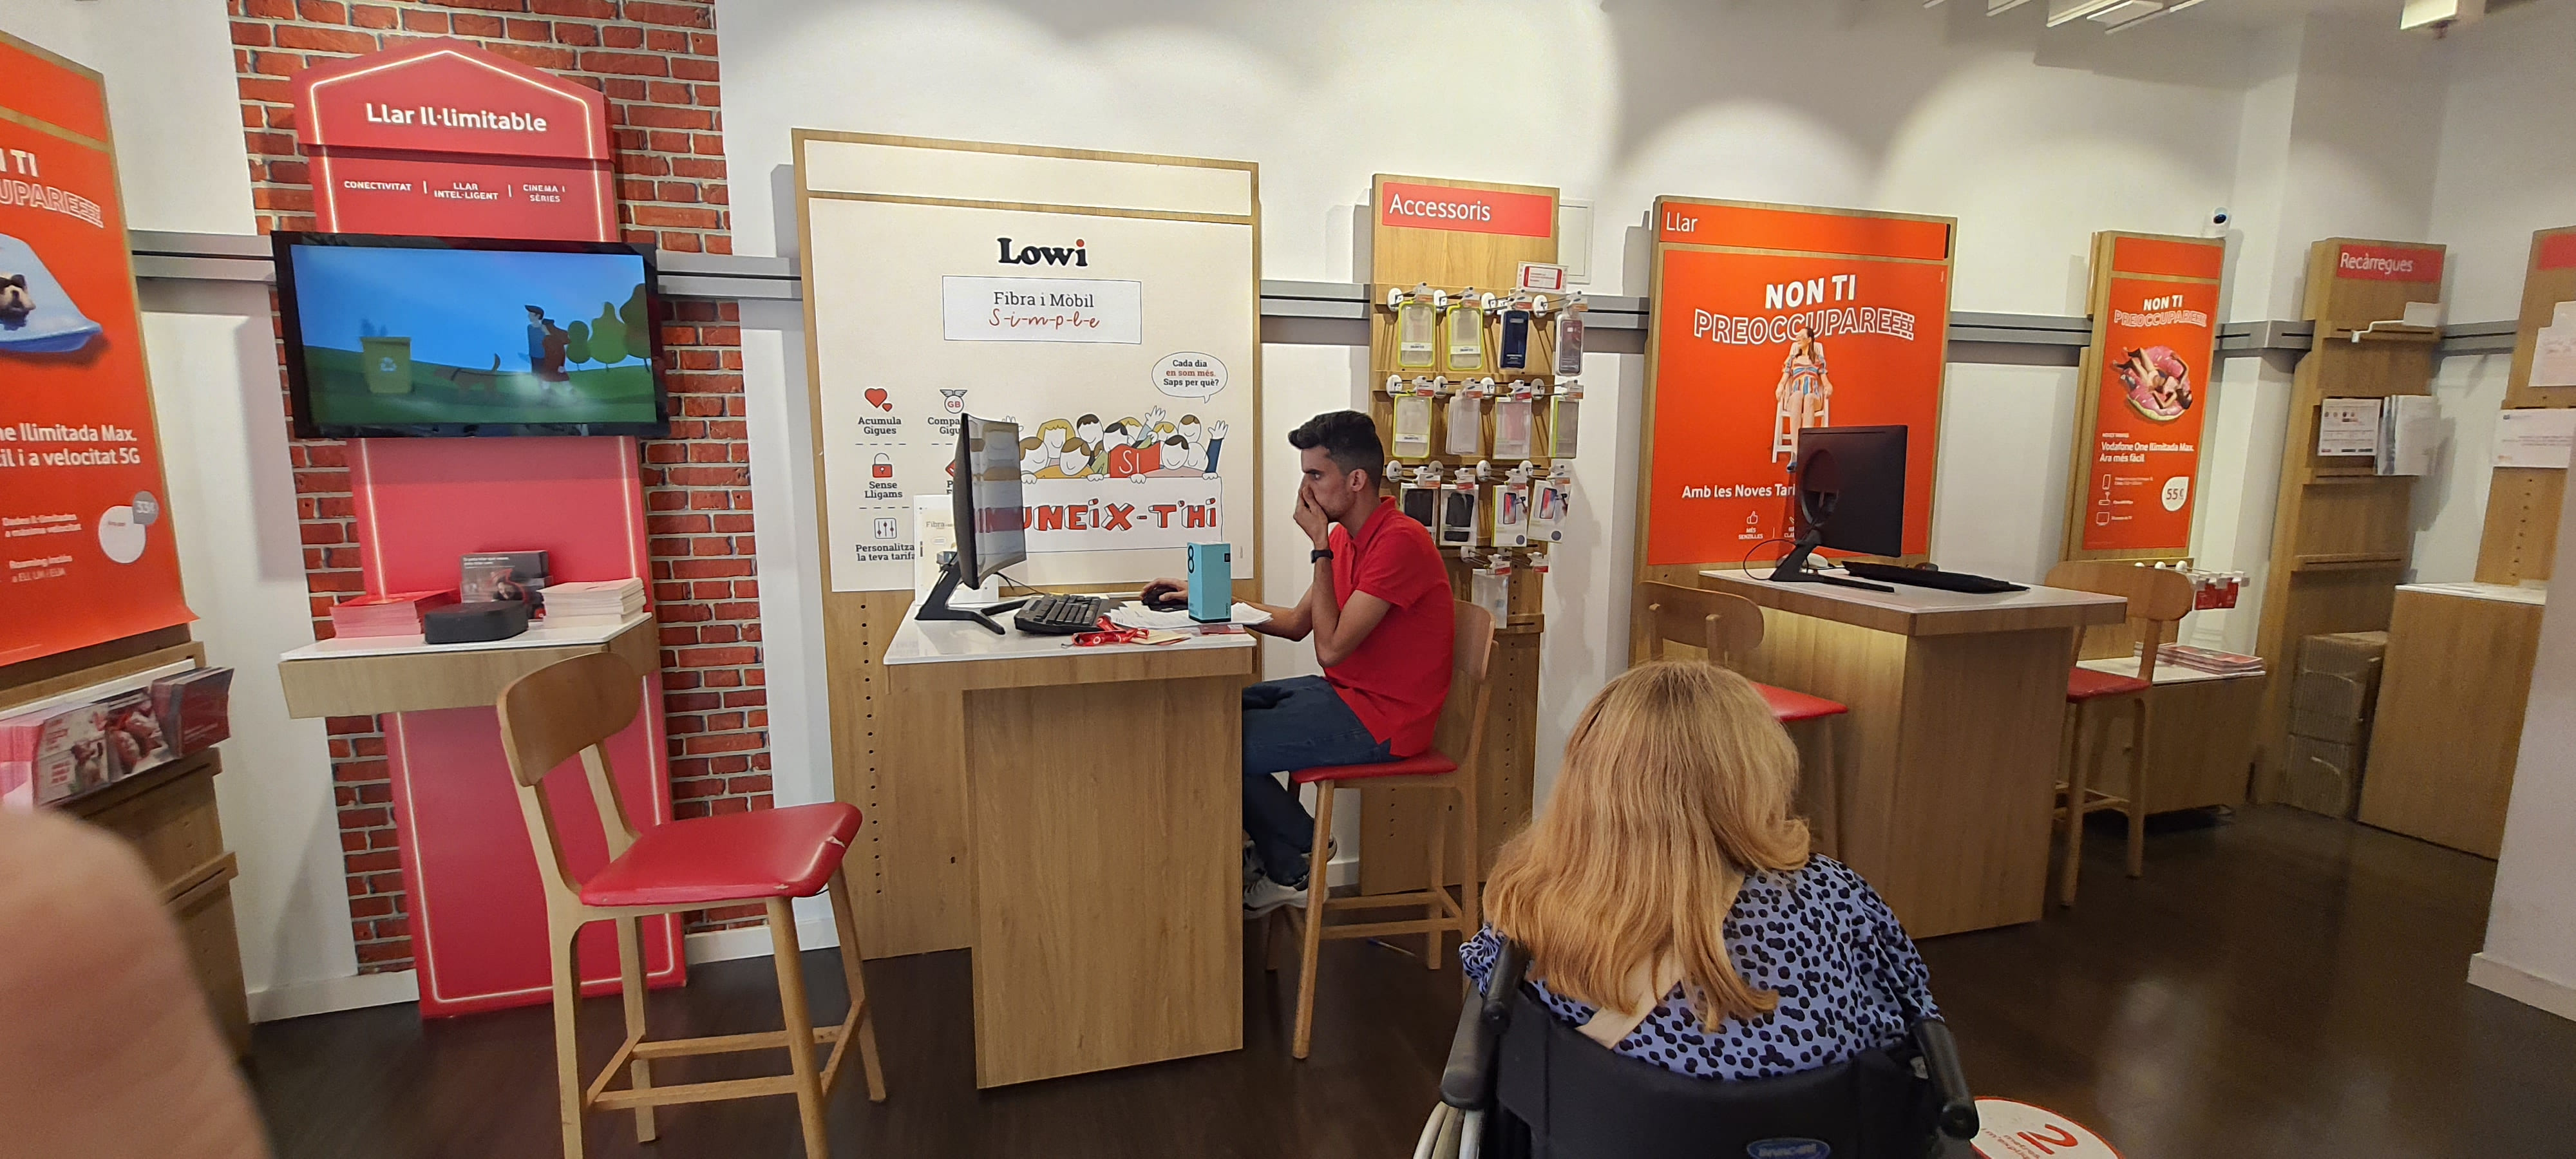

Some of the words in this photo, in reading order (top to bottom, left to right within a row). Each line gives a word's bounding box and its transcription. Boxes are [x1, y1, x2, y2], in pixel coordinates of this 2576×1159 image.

[366, 103, 415, 124] Llar
[10, 149, 39, 177] TI
[344, 180, 412, 191] CONECTIVITAT
[453, 182, 478, 191] LLAR
[523, 184, 558, 193] CINEMA
[529, 193, 561, 203] SÈRIES
[1389, 193, 1492, 221] Accessoris
[1665, 211, 1698, 232] Llar
[997, 238, 1088, 267] Lowi
[2340, 252, 2414, 275] Recàrregues
[1765, 278, 1825, 309] NON
[1832, 274, 1857, 301] TI
[994, 291, 1036, 306] Fibra
[1040, 292, 1046, 306] i
[1050, 293, 1095, 308] Mòbil
[2143, 296, 2170, 311] NON
[2172, 294, 2183, 308] TI
[1197, 369, 1216, 377] més.
[1164, 378, 1183, 387] Saps
[1200, 379, 1219, 388] què?
[858, 417, 902, 425] Acumula
[927, 417, 961, 427] Compa
[19, 422, 99, 442] Ilimitada
[101, 425, 138, 442] Max.
[864, 426, 896, 436] Gigues
[939, 426, 961, 436] Gigu
[2101, 441, 2134, 451] Vodafone
[2134, 442, 2149, 451] One
[17, 448, 25, 466] i
[28, 453, 40, 466] a
[42, 448, 118, 466] velocitat
[118, 447, 140, 464] 5G
[1119, 449, 1139, 474] SI
[2099, 453, 2112, 462] Ara
[2113, 453, 2128, 462] més
[869, 481, 898, 489] Sense
[864, 490, 903, 500] Lligams
[1681, 485, 1710, 498] Amb
[1714, 485, 1732, 498] les
[1734, 484, 1772, 497] Noves
[1774, 483, 1795, 496] Tari
[855, 543, 914, 552] Personalitza
[891, 552, 914, 560] tarifa
[1188, 545, 1195, 574] 8
